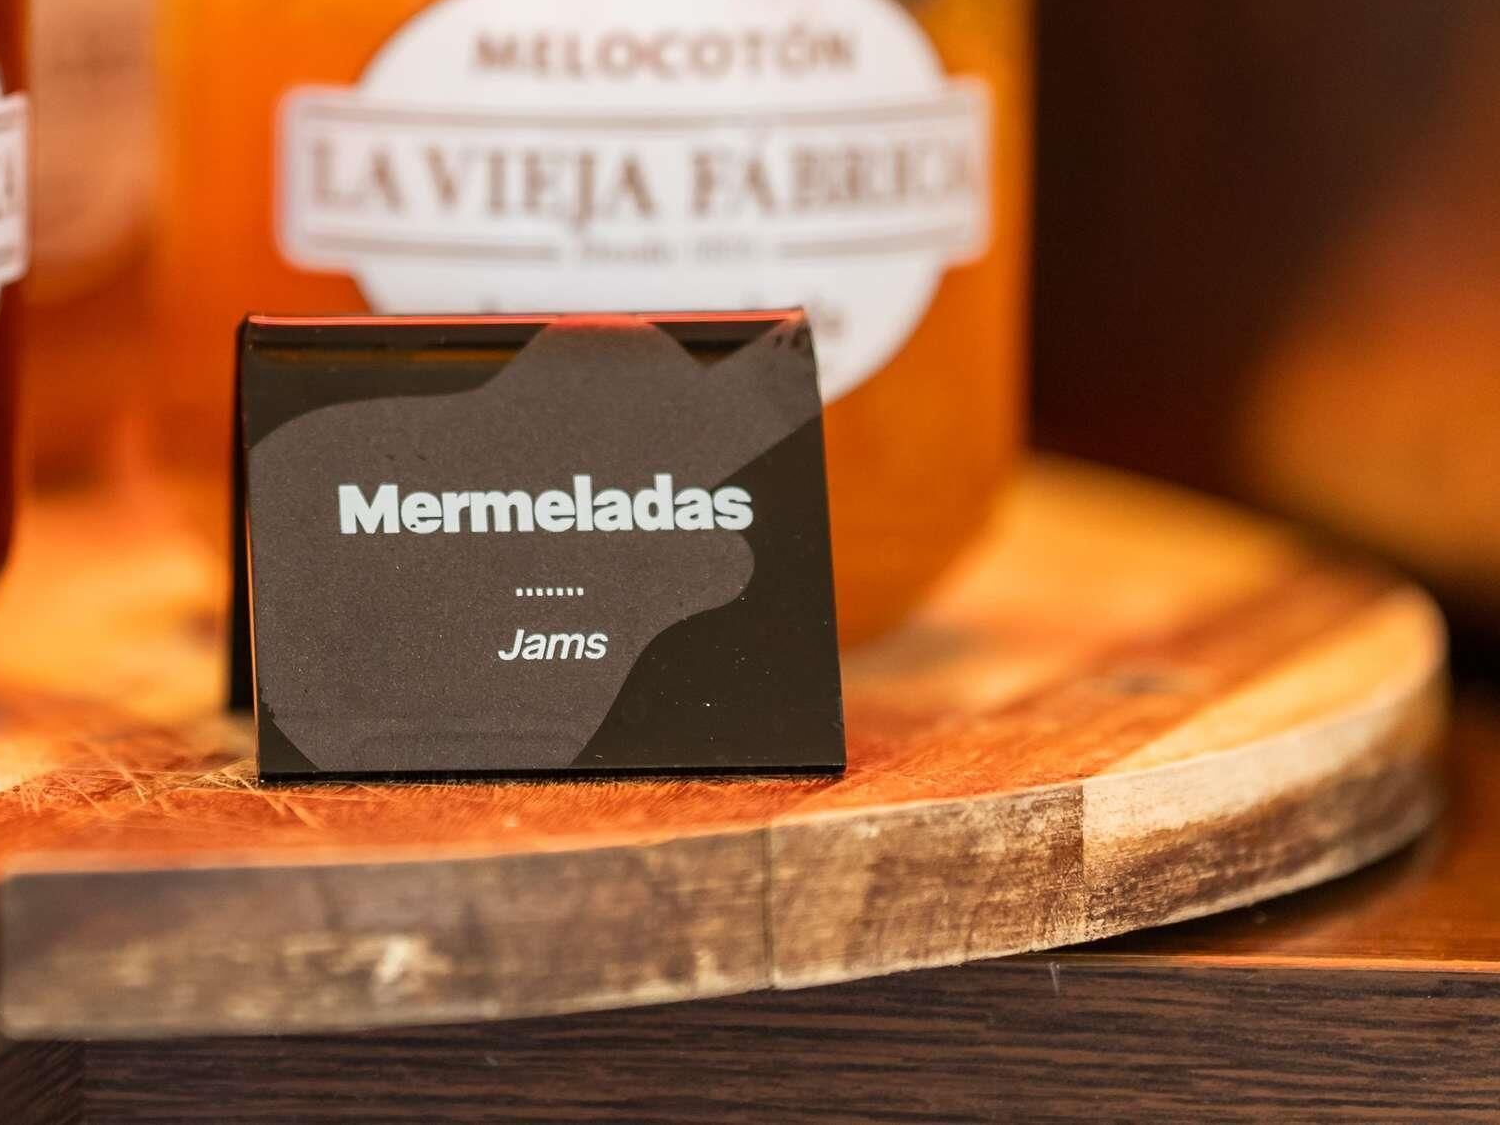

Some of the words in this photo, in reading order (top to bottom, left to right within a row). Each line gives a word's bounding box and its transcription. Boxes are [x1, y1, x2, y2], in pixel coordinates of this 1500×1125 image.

[470, 22, 859, 75] MELOCOTÓN
[309, 138, 414, 212] LA
[416, 142, 662, 225] VIEJA
[337, 474, 754, 535] Mermeladas
[498, 629, 609, 661] Jams
